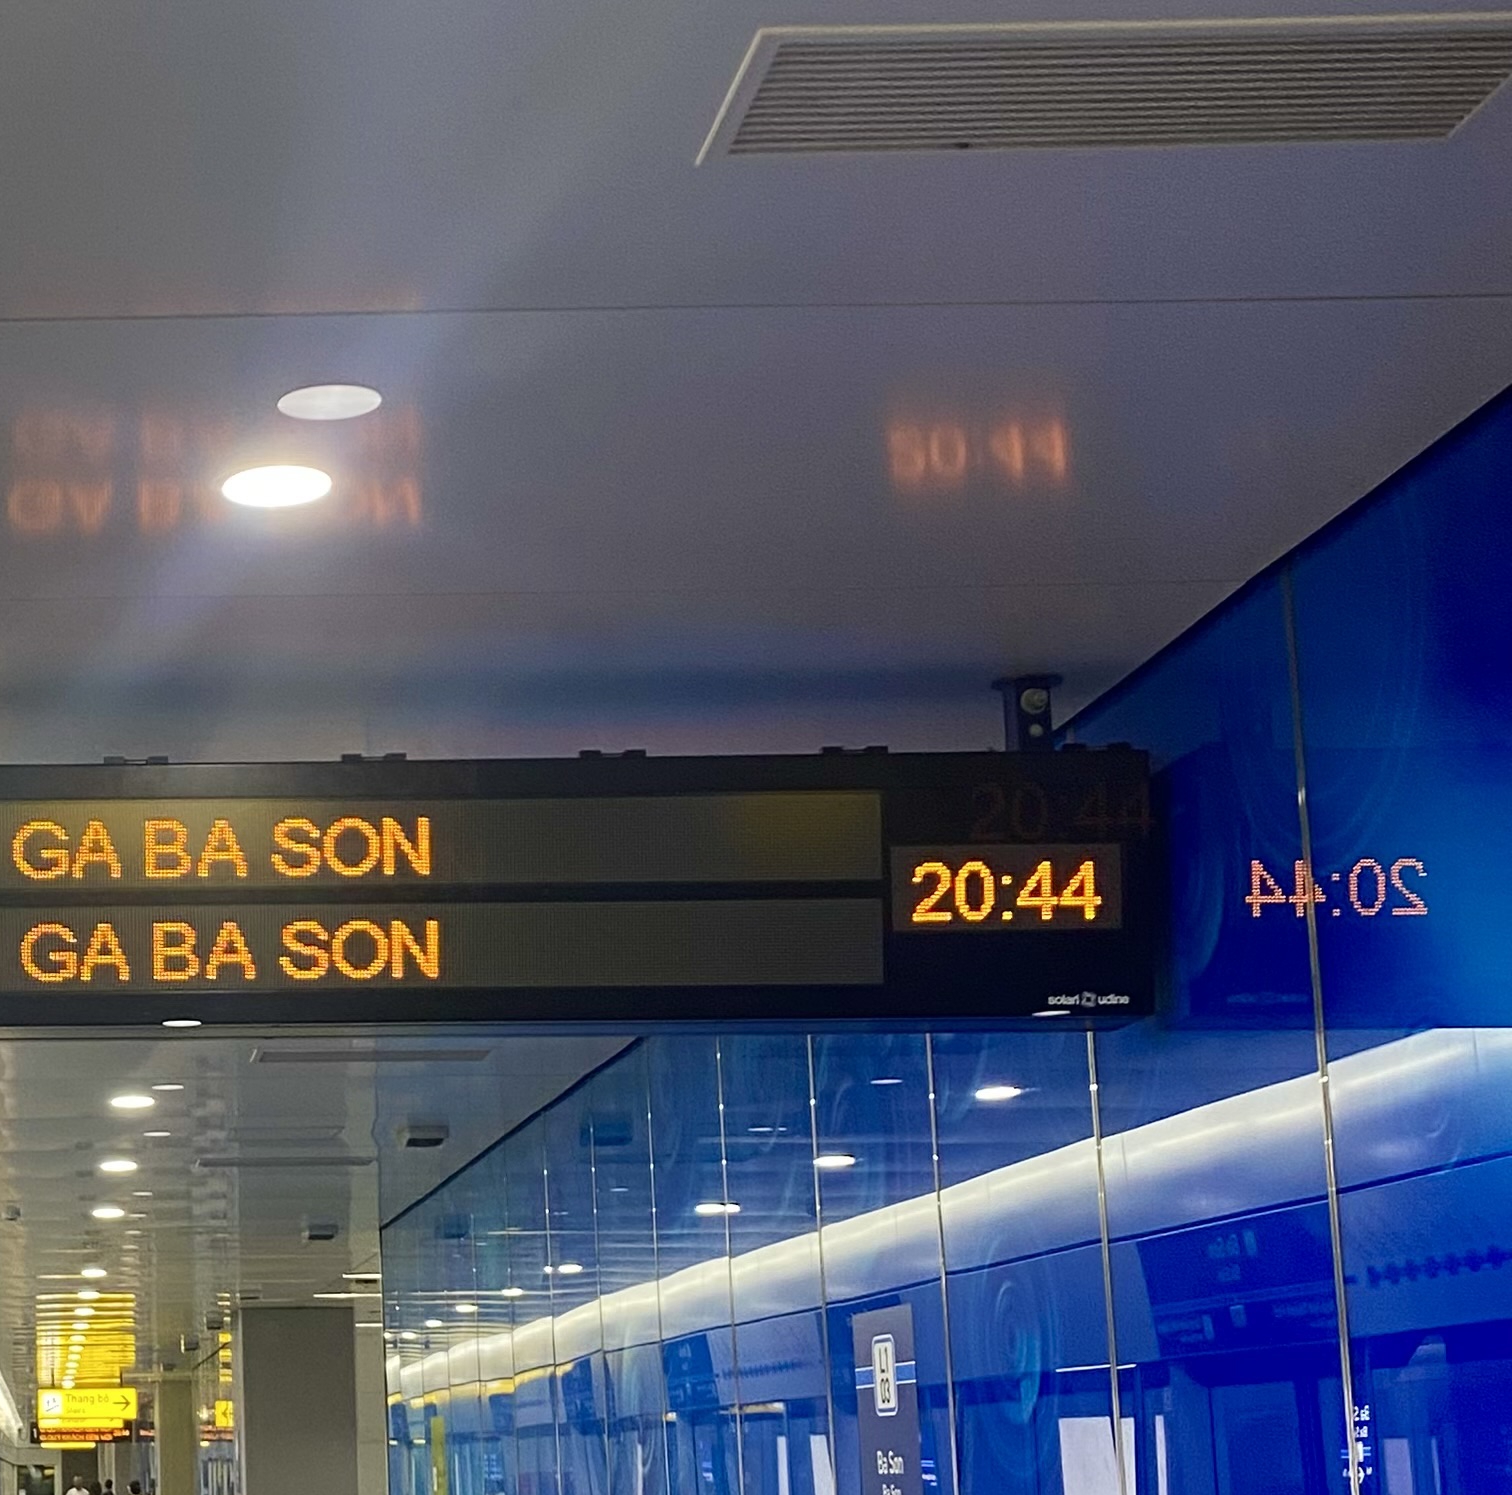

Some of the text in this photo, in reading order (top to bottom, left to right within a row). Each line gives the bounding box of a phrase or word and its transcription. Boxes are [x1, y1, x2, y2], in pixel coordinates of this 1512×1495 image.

[11, 819, 122, 880] GA
[143, 817, 248, 879] BA
[270, 816, 432, 879] SON
[910, 860, 1101, 923] 20:44
[19, 922, 130, 982] GA
[151, 920, 257, 981] BA
[278, 918, 440, 980] SON
